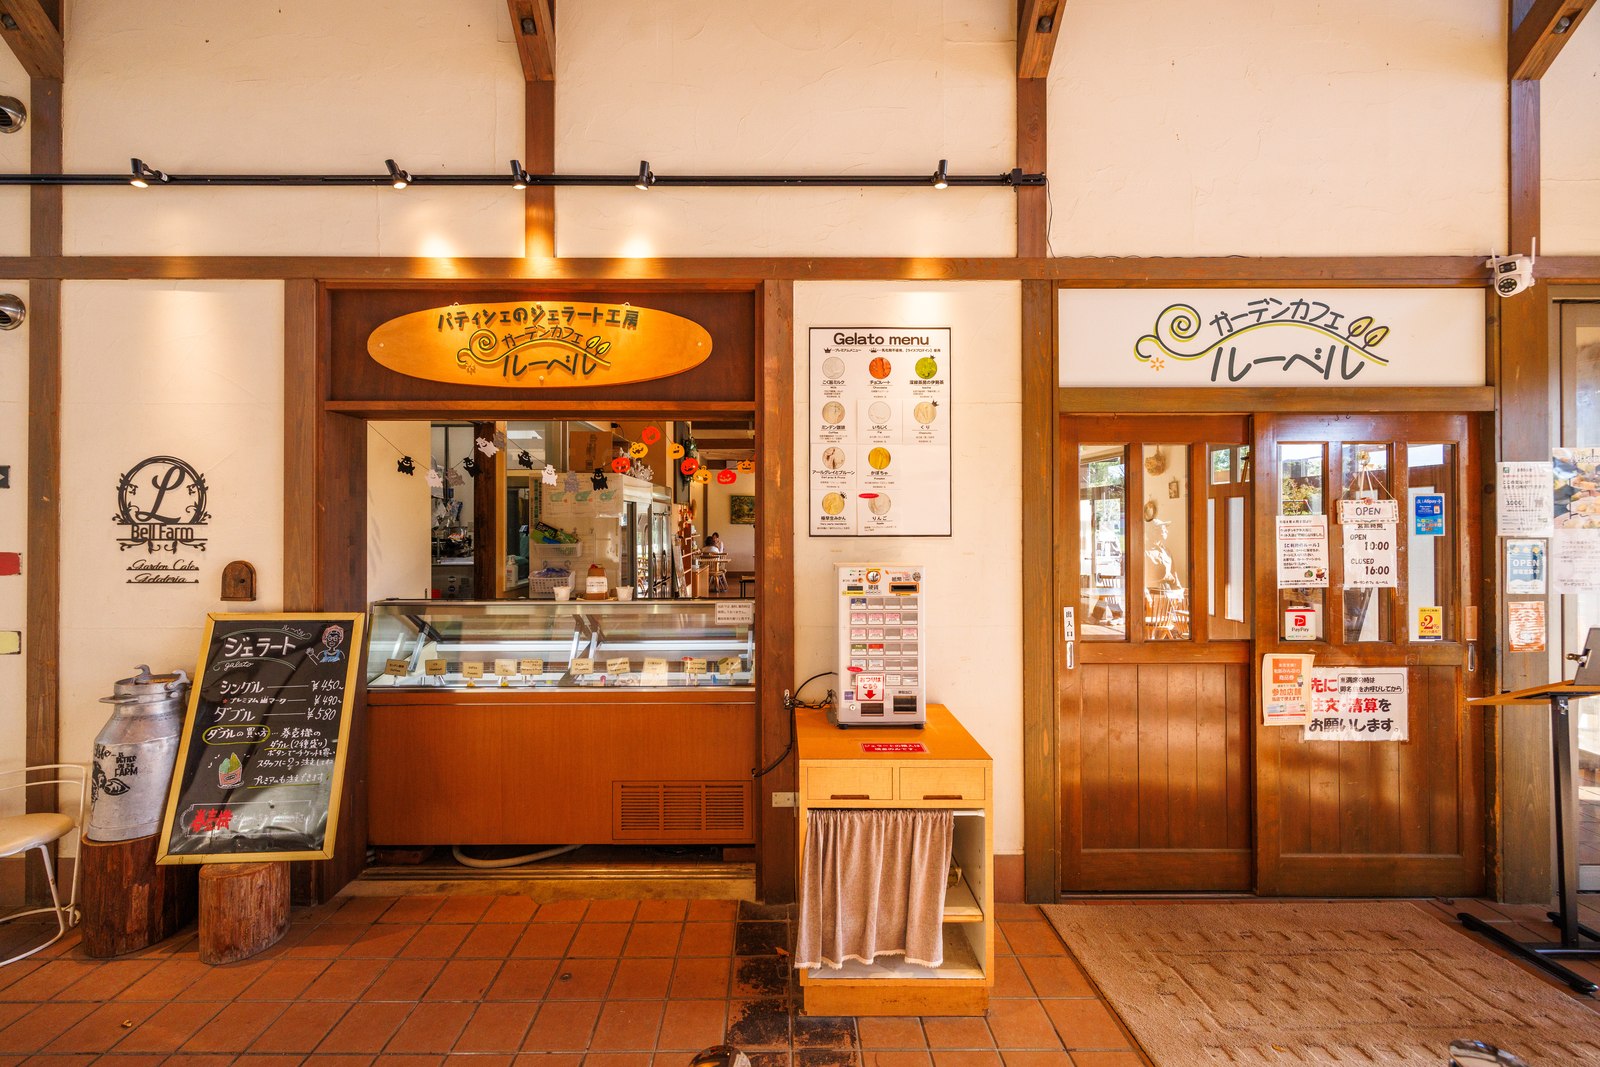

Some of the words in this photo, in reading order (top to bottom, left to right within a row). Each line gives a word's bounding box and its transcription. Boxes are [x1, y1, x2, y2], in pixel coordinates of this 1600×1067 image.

[1209, 298, 1344, 337] ガーデンカフェ
[501, 325, 584, 350] ガーデンカフェ
[833, 332, 884, 345] Gelato
[889, 336, 930, 345] menu
[502, 353, 597, 377] ルーベル
[1210, 345, 1365, 382] ルーベル
[1355, 507, 1381, 516] OPEN
[131, 523, 156, 541] Bell
[159, 523, 194, 541] Farm
[1364, 541, 1389, 550] 10:00
[131, 559, 169, 570] Garden
[172, 559, 195, 570] Cafe
[1512, 559, 1540, 567] OPEN
[1365, 566, 1390, 575] 16:00
[134, 573, 187, 584] Gelateria
[224, 636, 297, 658] ジェラート
[219, 680, 265, 695] シングル
[1271, 688, 1302, 696] 参加店舗
[214, 706, 256, 723] ダブル
[306, 707, 337, 721] ¥580
[1309, 717, 1399, 732] お願いします。
[207, 726, 269, 742] ダブルの買い方
[115, 755, 137, 764] BETTER
[114, 767, 138, 778] FARM
